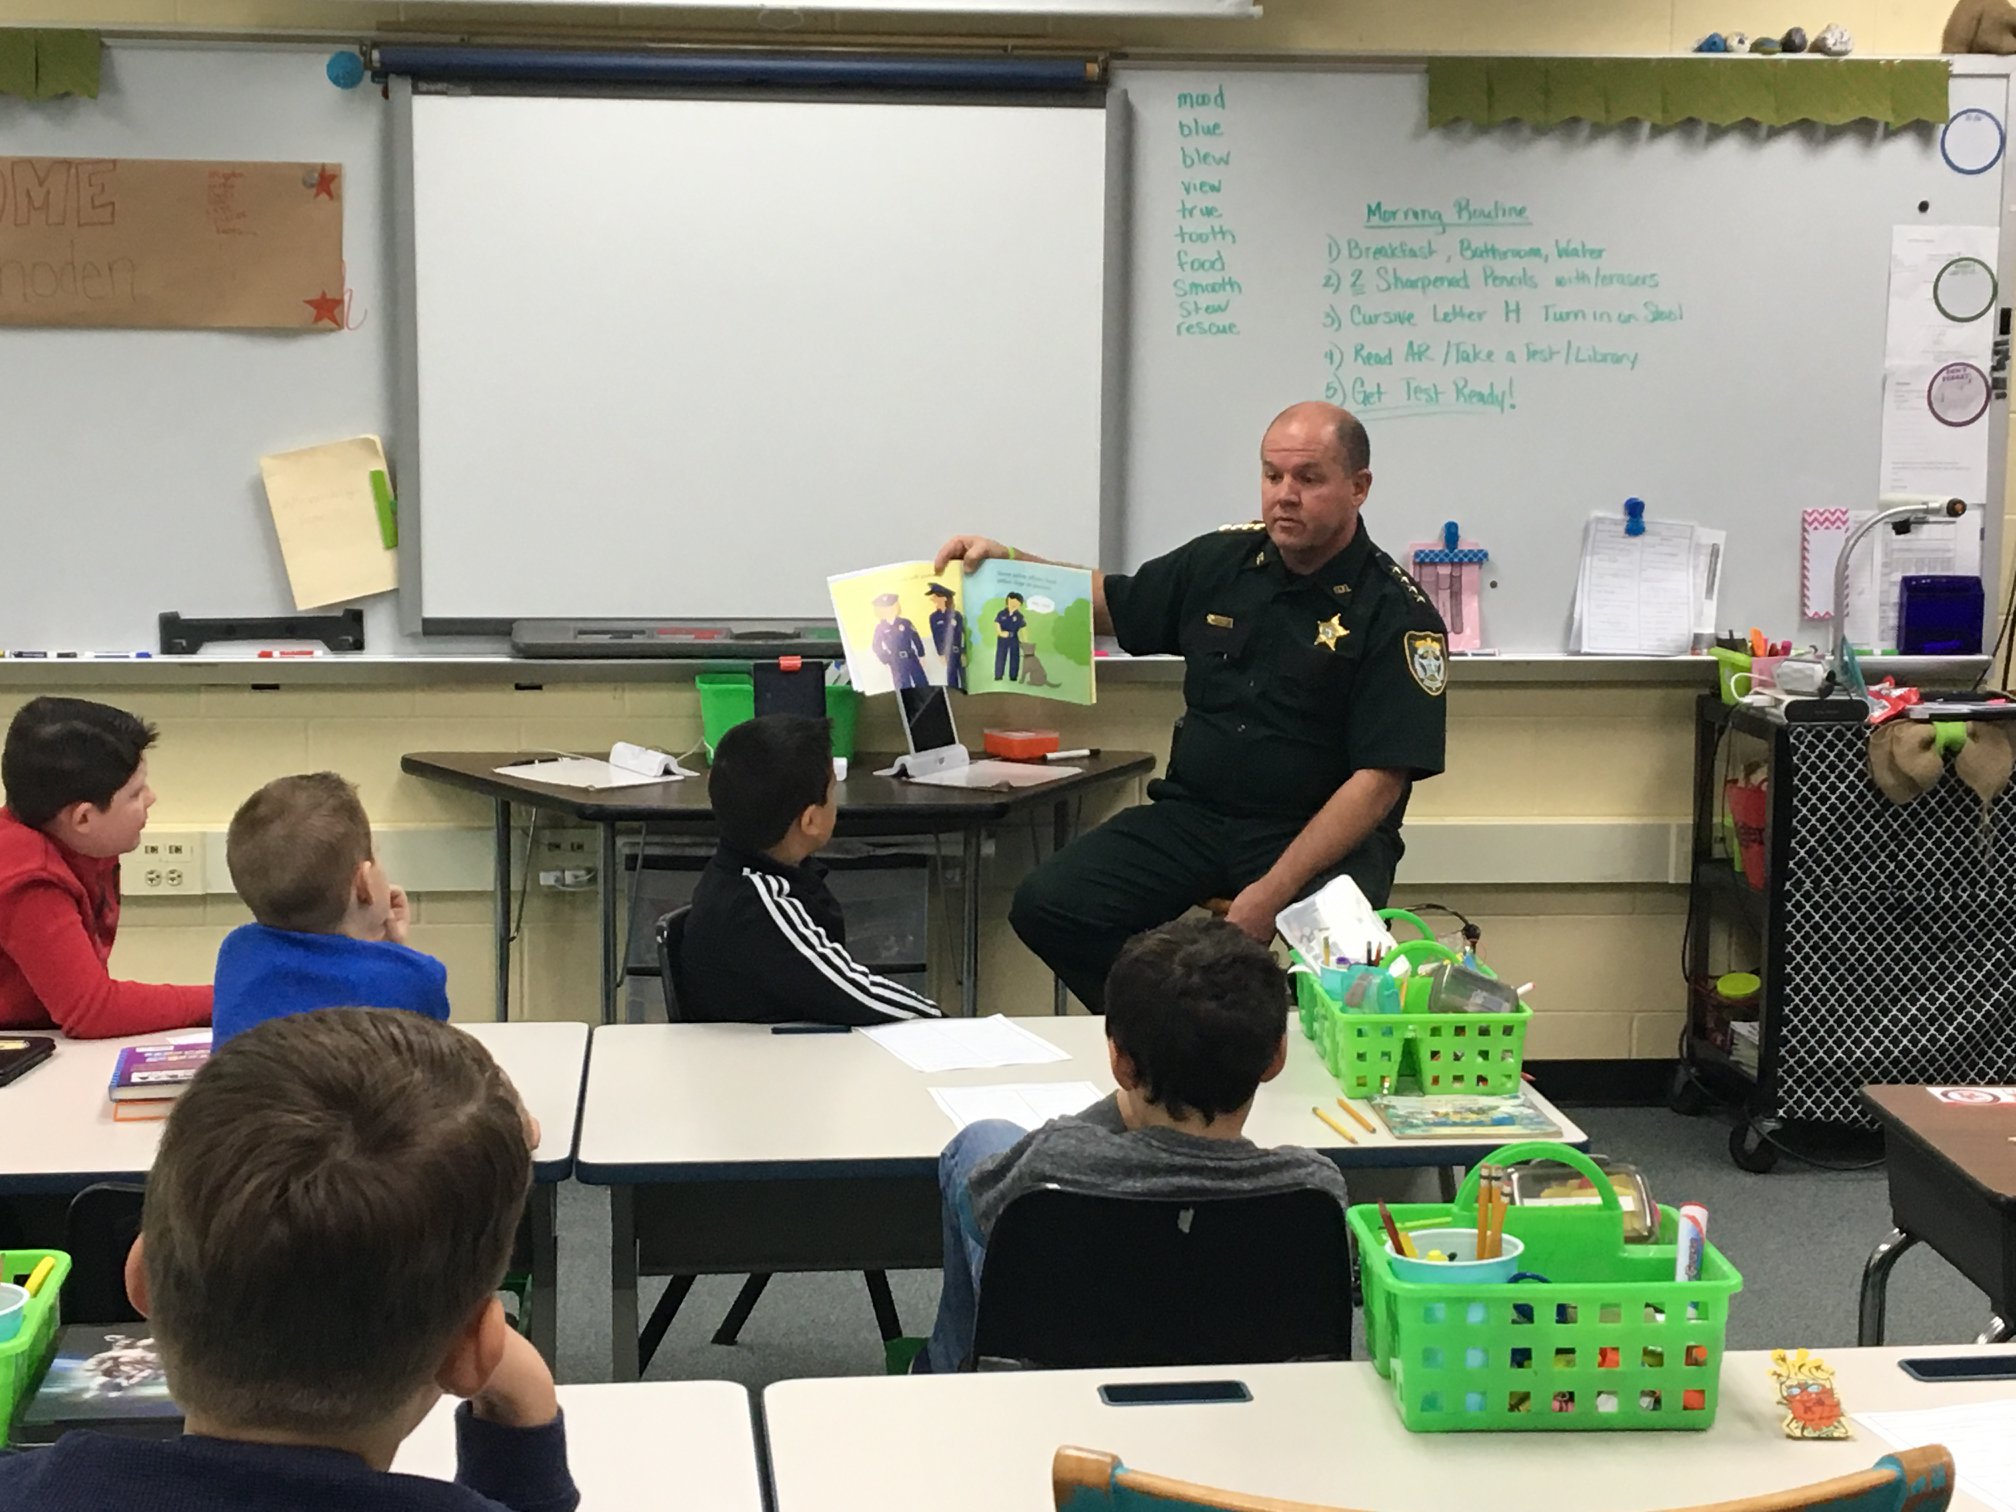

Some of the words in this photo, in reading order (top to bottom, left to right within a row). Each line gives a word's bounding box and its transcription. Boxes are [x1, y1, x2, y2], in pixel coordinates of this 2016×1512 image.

[1178, 118, 1223, 138] blue
[1180, 146, 1231, 169] blew
[1181, 179, 1222, 195] view
[1176, 199, 1223, 219] true
[1366, 200, 1447, 235] Morning
[1453, 197, 1529, 222] Routine
[1174, 224, 1237, 244] tooth
[1326, 233, 1341, 264] 1)
[1555, 238, 1606, 260] Water
[1177, 249, 1226, 273] food
[1322, 267, 1341, 295] 2)
[1376, 266, 1471, 295] Sharpened
[1483, 264, 1539, 290] Pencils
[1176, 320, 1240, 336] rescue
[1322, 303, 1342, 333] 3)
[1350, 303, 1418, 327] Cursive
[1432, 303, 1488, 324] Letter
[1504, 299, 1521, 325] H
[1542, 303, 1586, 323] Turn
[1593, 308, 1613, 324] in
[1323, 340, 1345, 373] 4)
[1352, 342, 1394, 367] Read
[1504, 350, 1517, 365] a
[1352, 376, 1387, 408] Get
[1400, 377, 1447, 404] Test
[1452, 376, 1517, 415] Ready!
